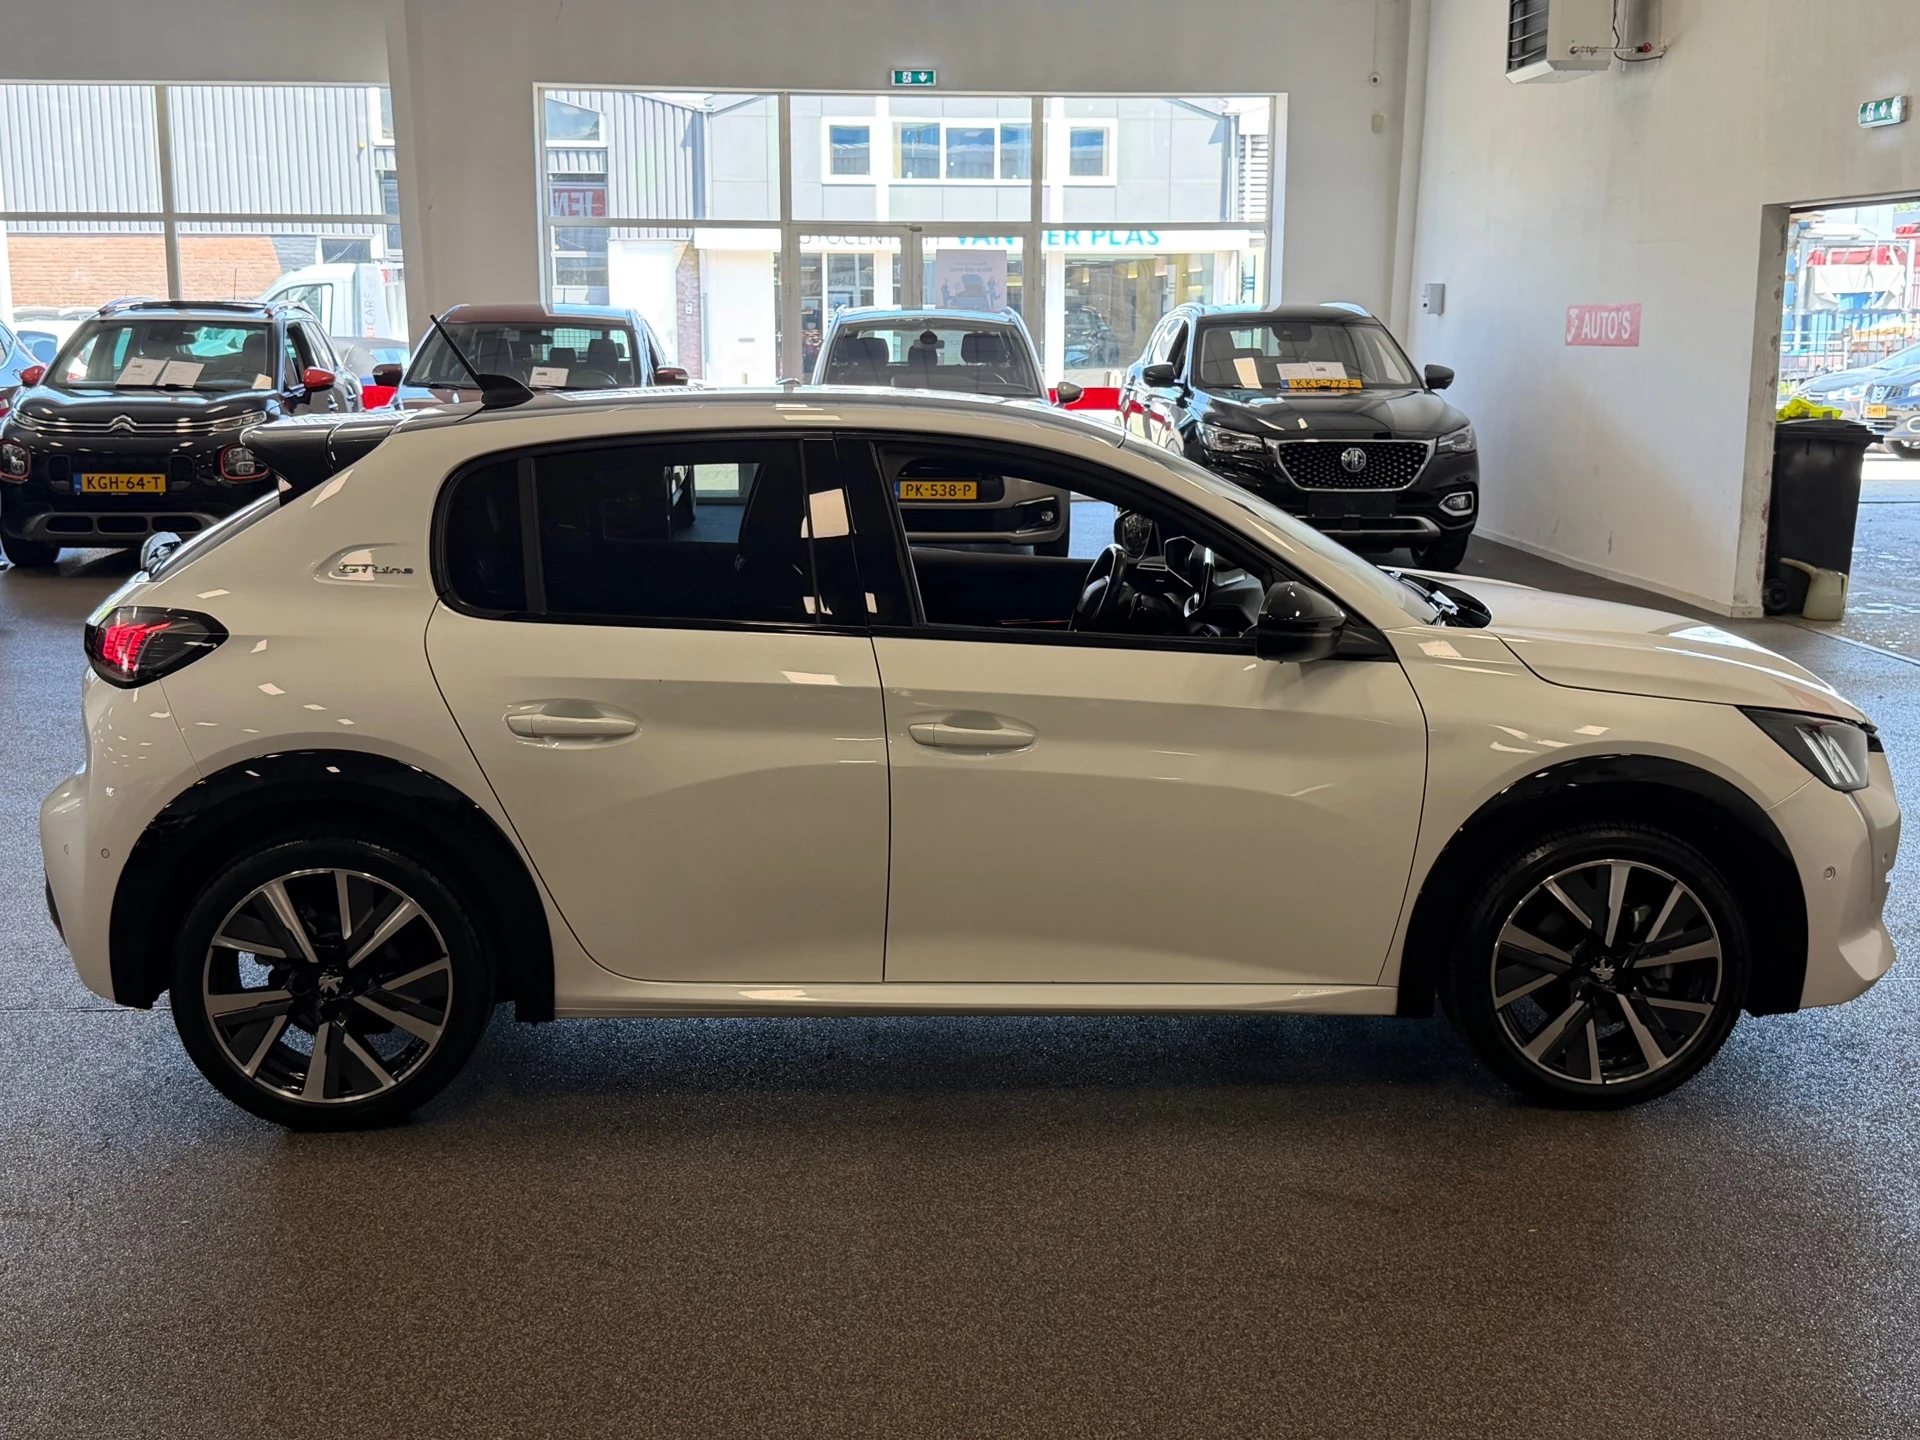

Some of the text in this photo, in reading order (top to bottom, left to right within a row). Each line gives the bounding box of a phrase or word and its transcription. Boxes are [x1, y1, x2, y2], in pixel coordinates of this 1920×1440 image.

[1042, 230, 1080, 246] ER
[1091, 230, 1160, 246] PLAS
[1581, 310, 1631, 340] AUTO'S
[86, 476, 161, 490] KGH-64-T
[905, 483, 972, 497] PK-538-P
